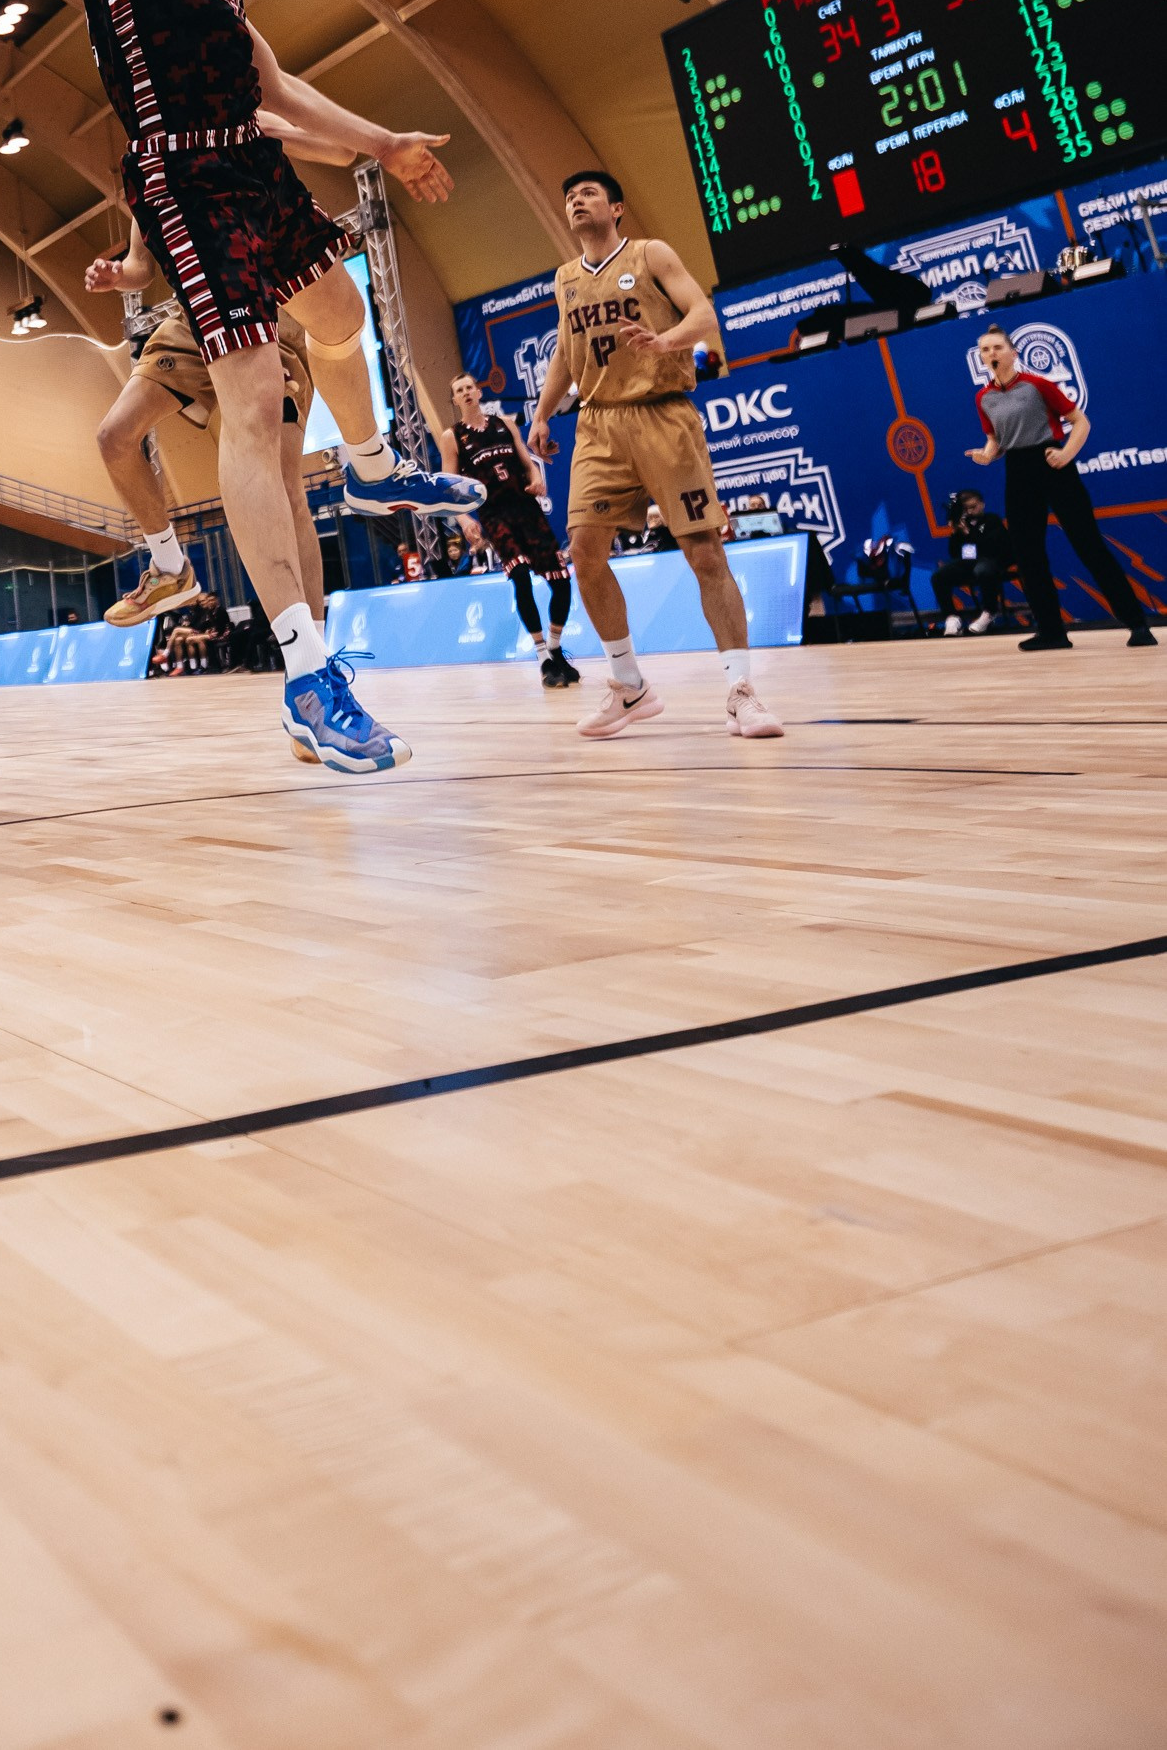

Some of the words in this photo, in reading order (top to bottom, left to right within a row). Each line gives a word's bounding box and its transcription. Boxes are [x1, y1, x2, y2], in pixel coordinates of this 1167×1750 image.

[818, 15, 862, 63] 34
[870, 29, 923, 61] ТАЙМАУТЫ
[868, 60, 904, 86] ВРЕМЯ
[906, 47, 935, 70] ИГРЫ
[877, 59, 968, 127] 2:01
[875, 130, 910, 154] ВРЕМЯ
[911, 108, 969, 141] ПЕРЕРЫВА
[1002, 109, 1038, 152] 4
[911, 150, 946, 194] 18
[229, 306, 251, 320] STK
[567, 297, 642, 335] ЦИВС
[721, 291, 778, 318] ЧЕМПИОНАТ
[725, 300, 801, 331] ФЕДЕРАЛЬНОГО
[800, 289, 841, 311] ОКРУГА
[705, 383, 793, 433] DKC
[743, 424, 800, 447] спонсор
[493, 462, 510, 482] 5
[407, 557, 422, 578] 5
